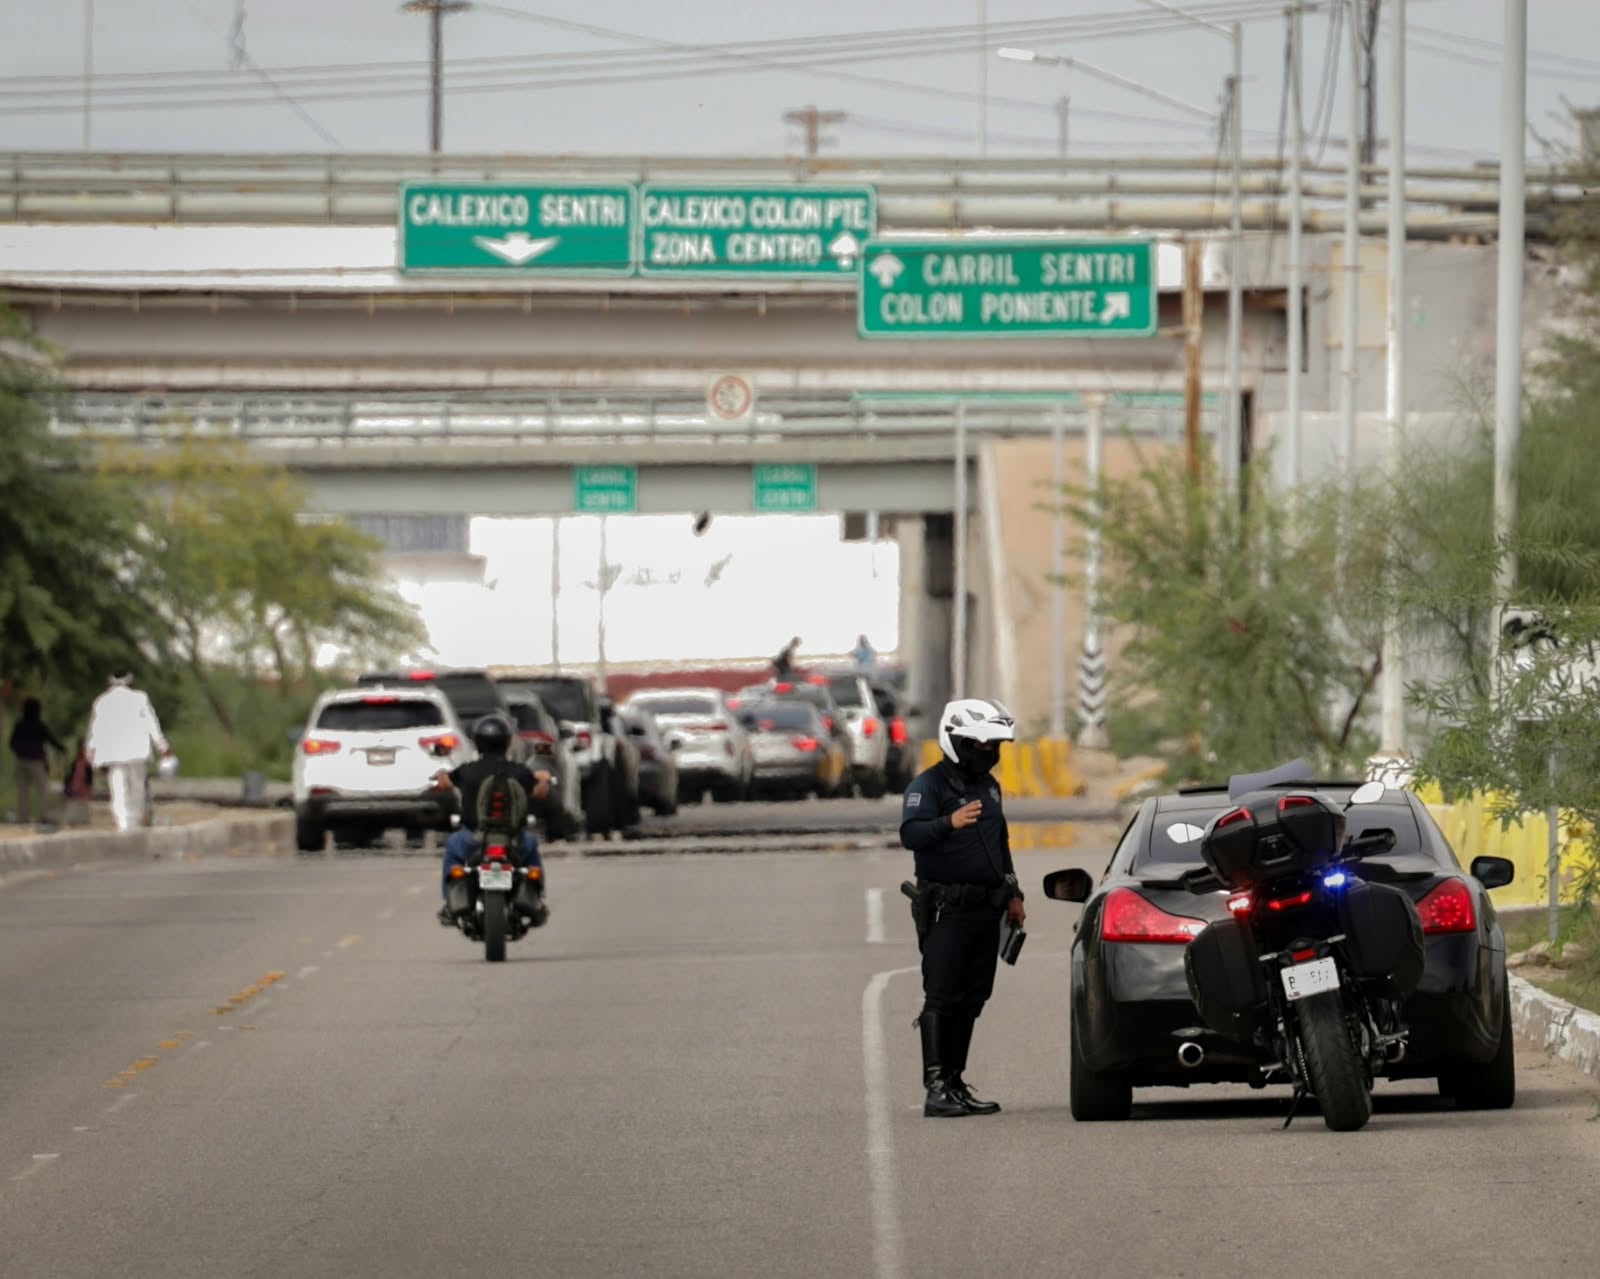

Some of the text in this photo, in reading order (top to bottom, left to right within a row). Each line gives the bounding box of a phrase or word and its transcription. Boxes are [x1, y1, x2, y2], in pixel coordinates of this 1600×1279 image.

[409, 194, 625, 227] CALEXICO SENTRI
[645, 197, 867, 229] CALEXICO COLON PTE
[652, 234, 822, 264] ZONA CENTRO
[922, 253, 1136, 285] CARRIL SENTRI
[880, 292, 1098, 324] COLON PONIENTE
